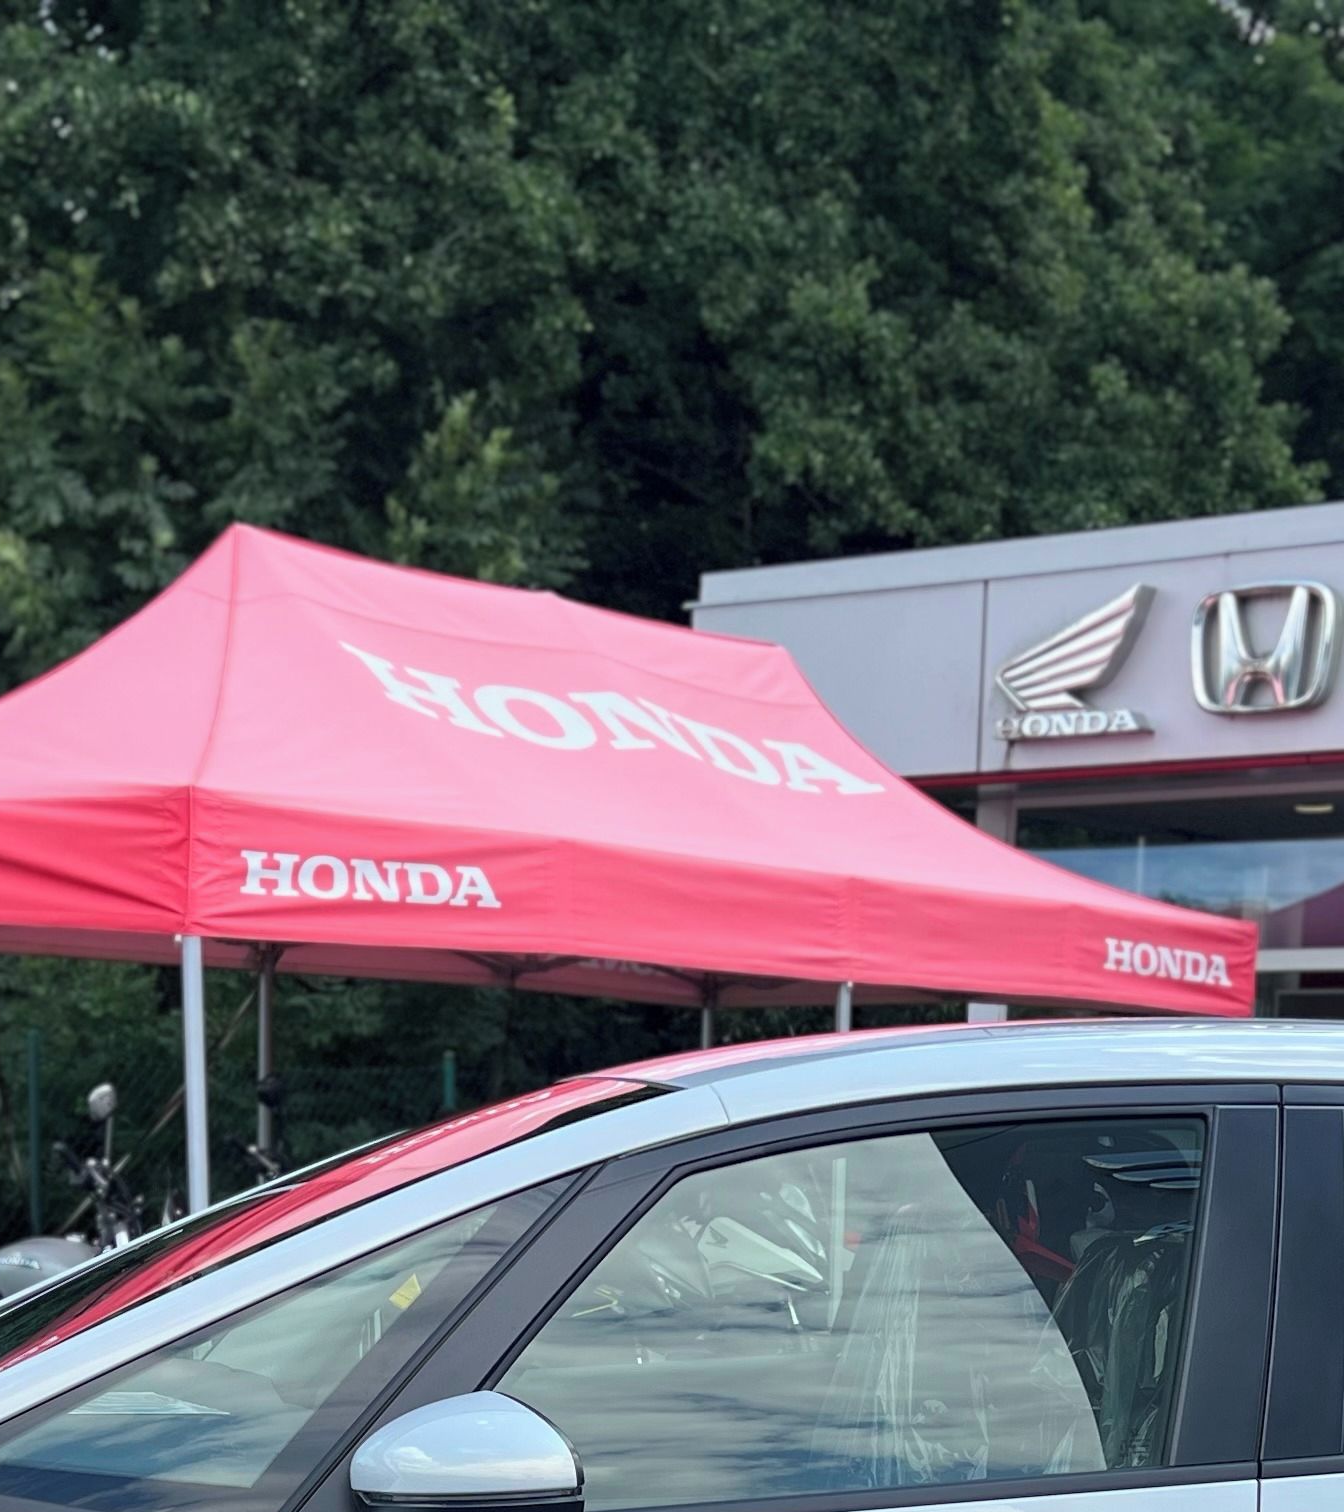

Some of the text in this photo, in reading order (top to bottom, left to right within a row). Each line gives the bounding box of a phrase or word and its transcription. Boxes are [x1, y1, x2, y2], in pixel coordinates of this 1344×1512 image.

[340, 641, 886, 795] HONDA
[240, 850, 502, 909] HONDA
[1103, 937, 1233, 988] HONDA
